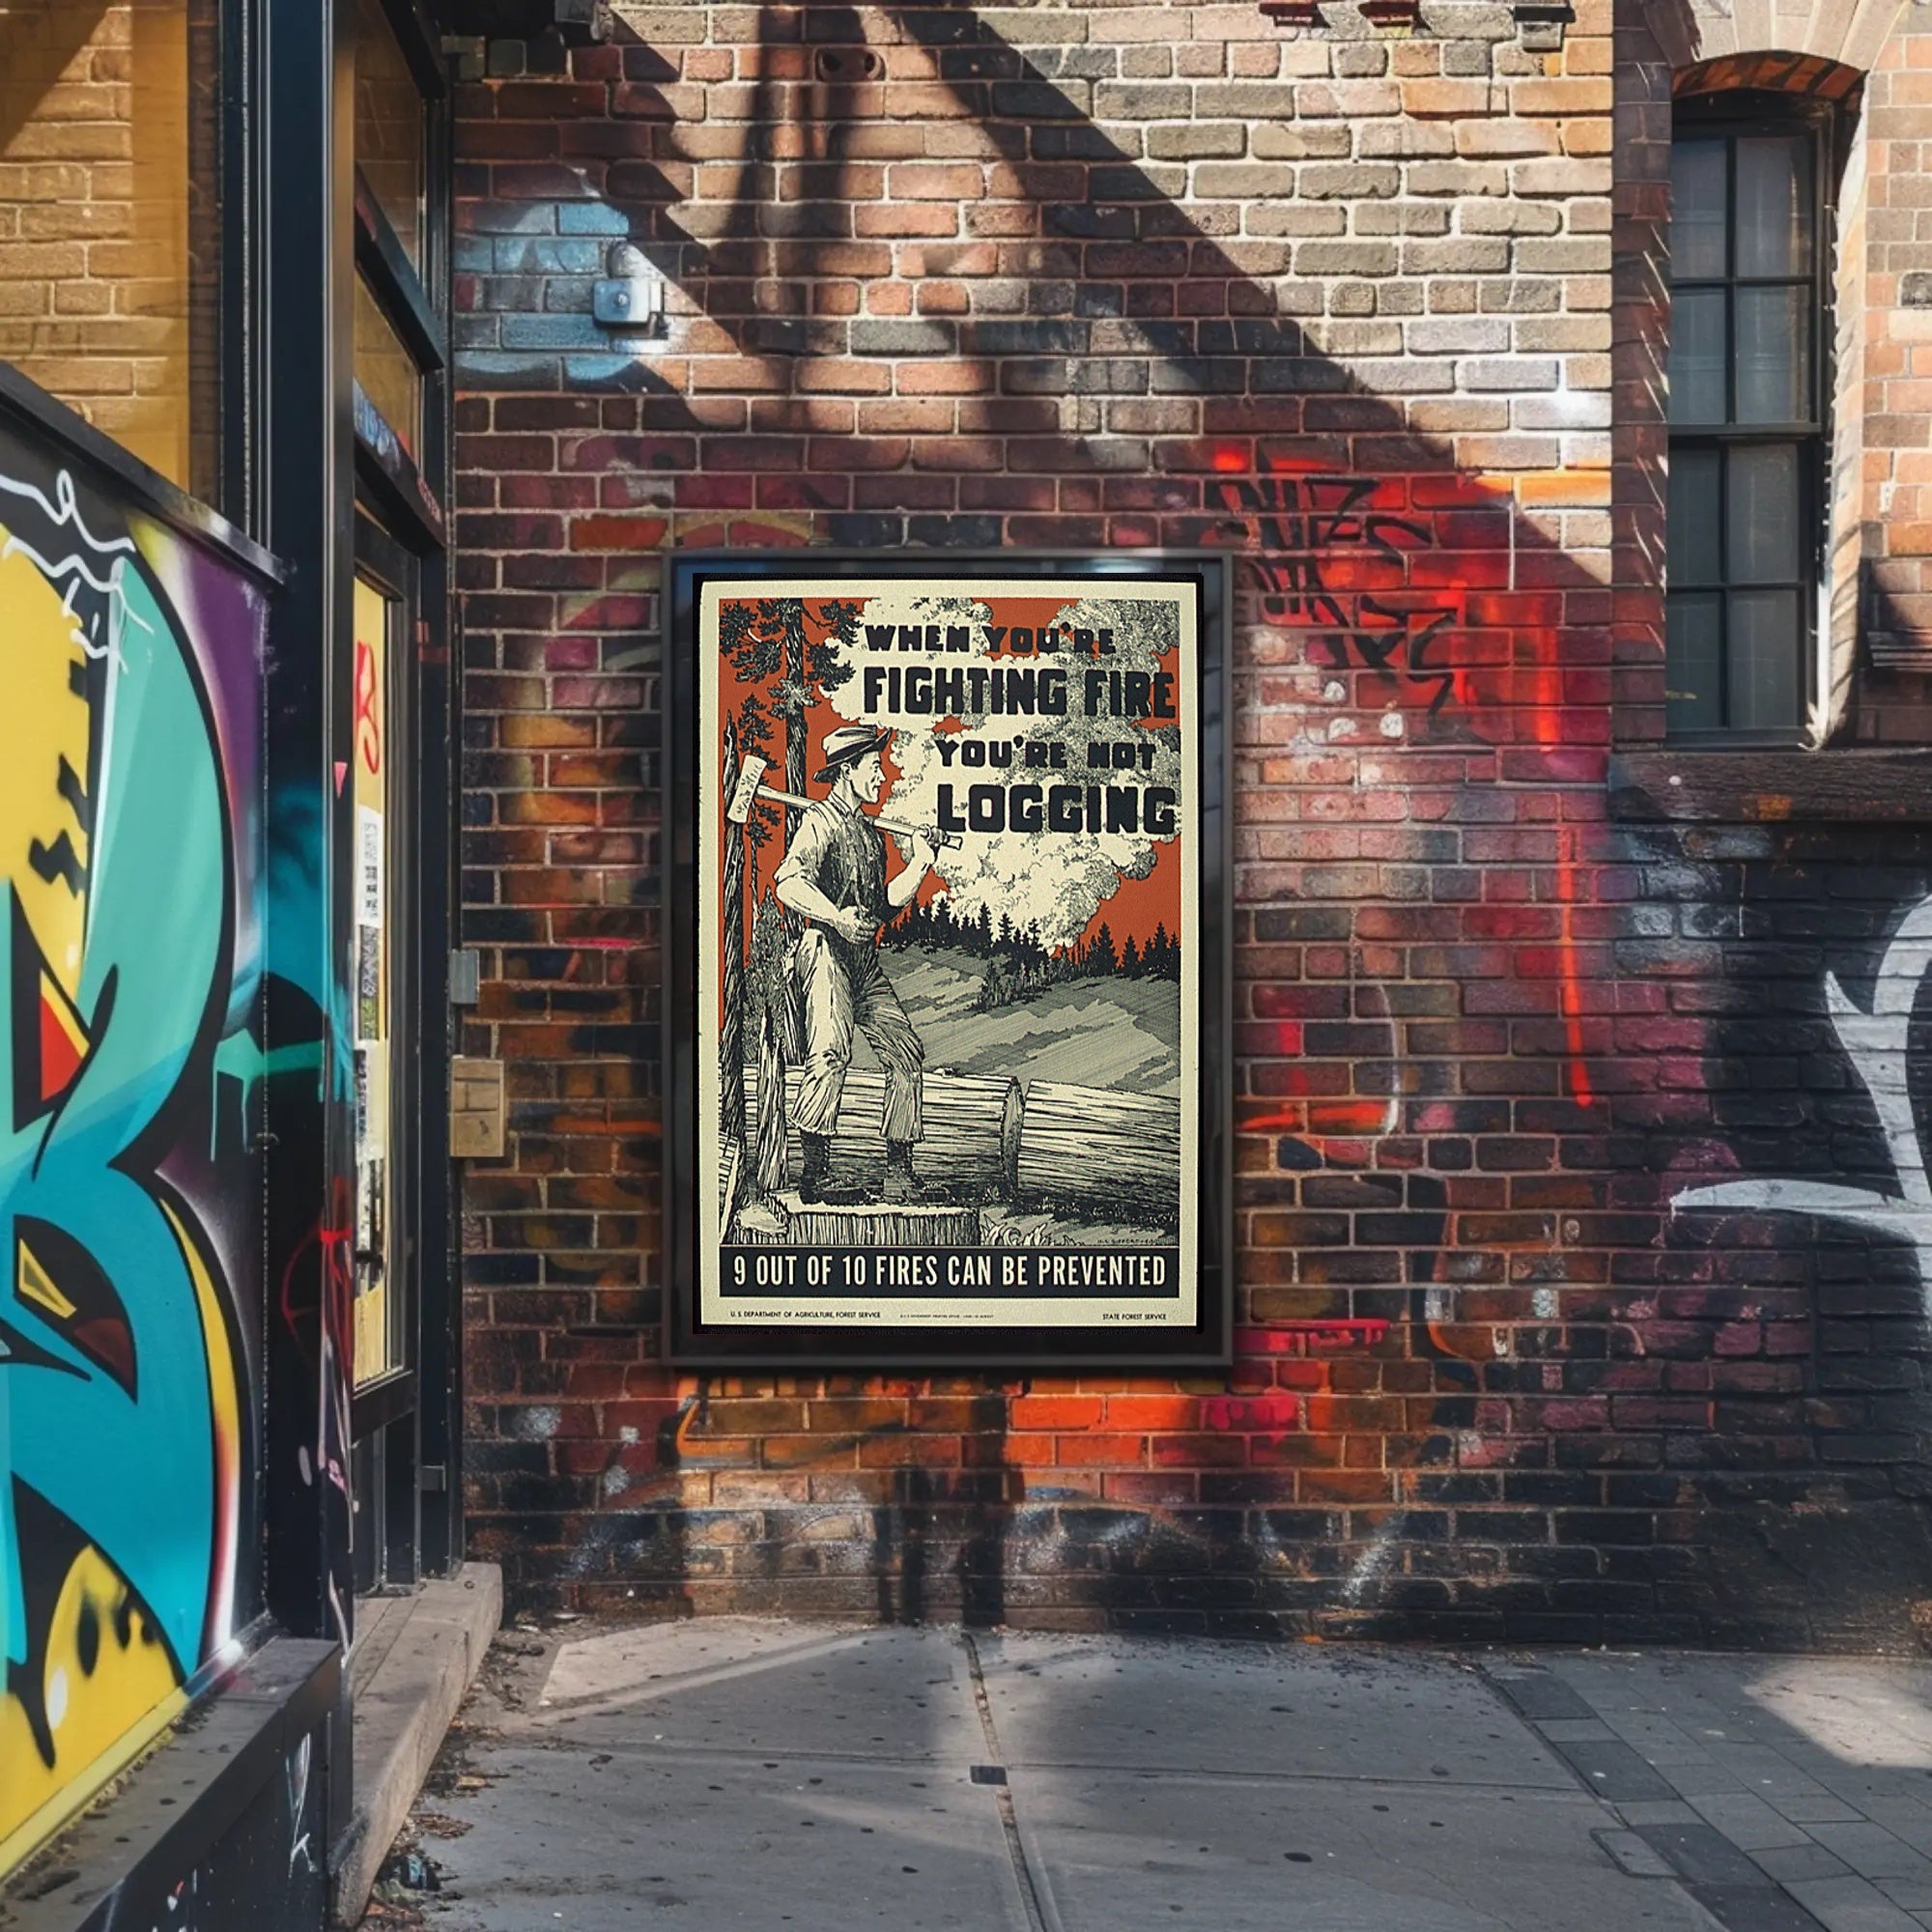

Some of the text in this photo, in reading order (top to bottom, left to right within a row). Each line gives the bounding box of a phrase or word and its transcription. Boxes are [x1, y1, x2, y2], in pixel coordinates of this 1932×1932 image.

[865, 621, 1117, 655] WHEN YOU'RE
[863, 667, 1177, 719] FIGHTING FIRE
[934, 734, 1156, 770] YOU'RE NOT
[936, 783, 1177, 835] LOGGING
[733, 1255, 1167, 1287] 9 OUT OF 10 FIRES CAN BE PREVENTED
